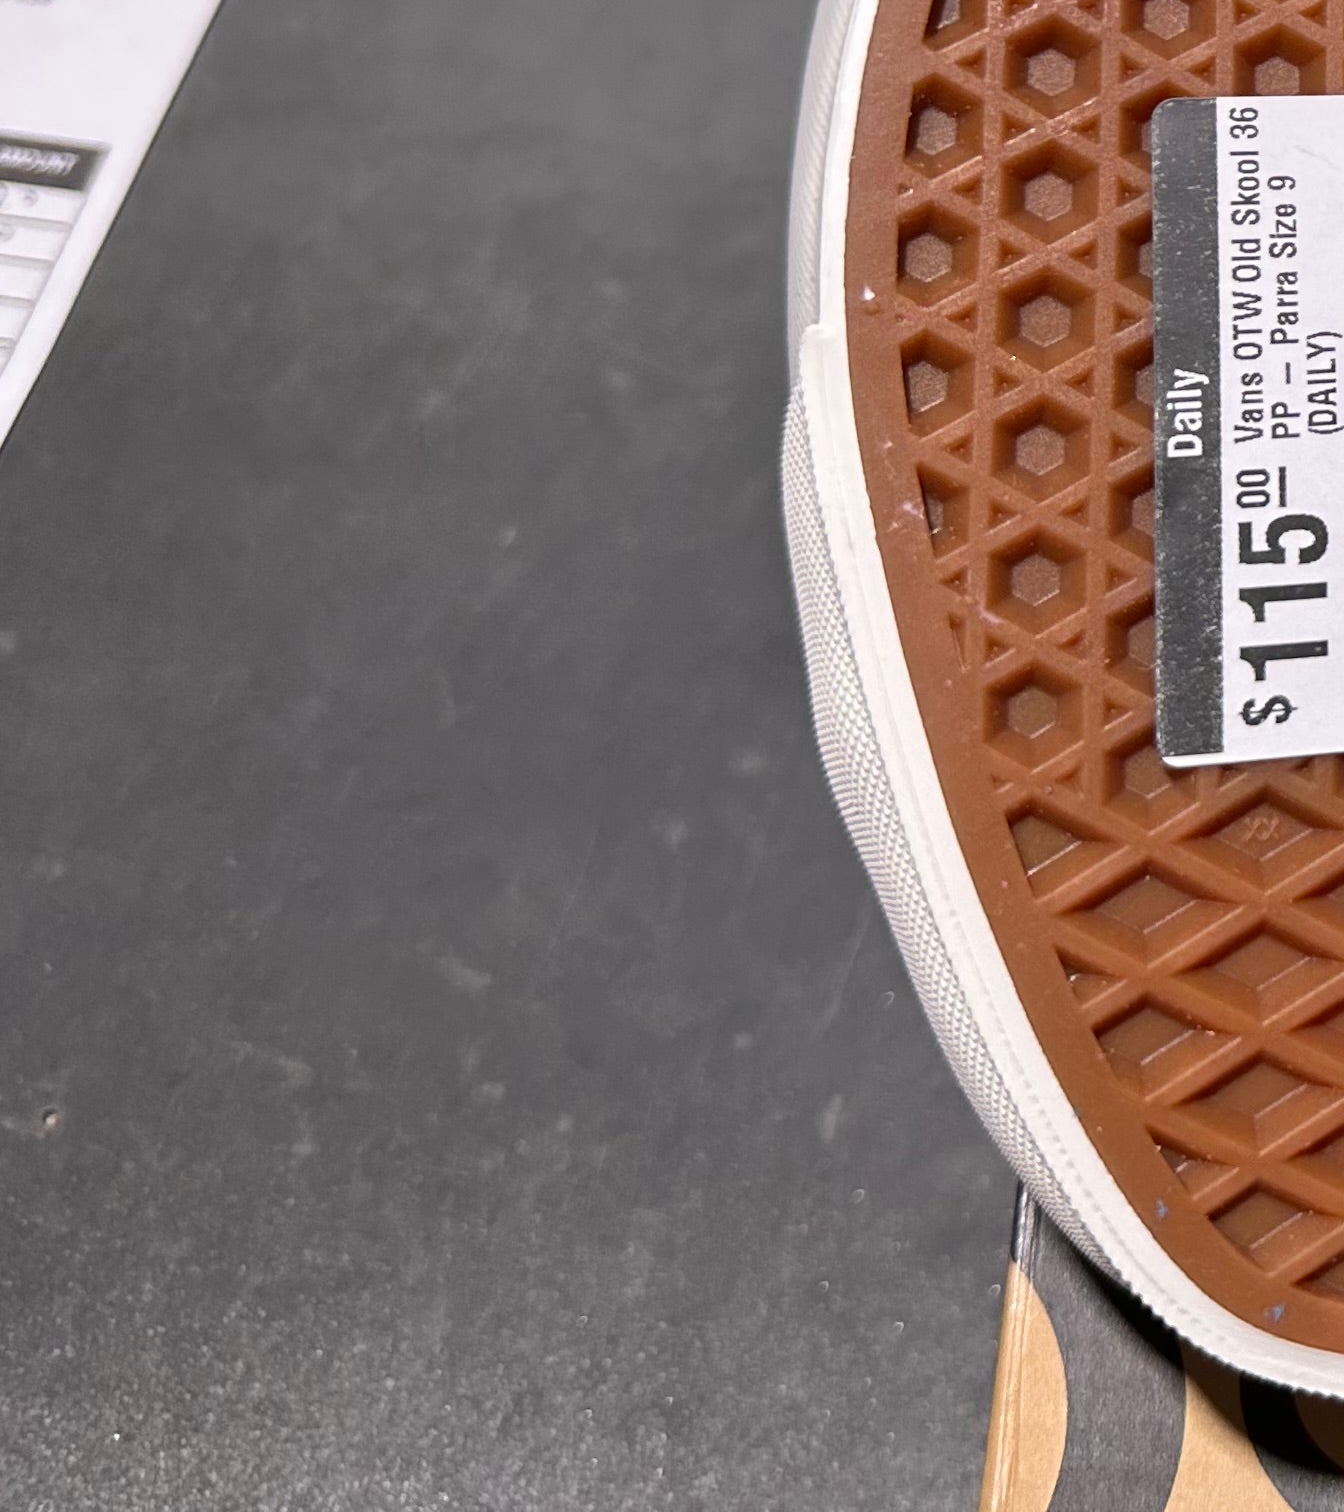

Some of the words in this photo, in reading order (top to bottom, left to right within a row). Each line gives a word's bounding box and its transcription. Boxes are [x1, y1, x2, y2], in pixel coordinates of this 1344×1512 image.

[1228, 106, 1259, 140] 36
[1228, 149, 1261, 226] Skool
[1265, 174, 1296, 191] 9
[1229, 237, 1262, 283] Old
[1267, 202, 1298, 259] Size
[1230, 290, 1263, 361] OTW
[1268, 270, 1300, 345] Parra
[1164, 367, 1210, 458] Daily
[1232, 371, 1264, 444] Vans
[1305, 330, 1344, 435] (DAILY)
[1269, 400, 1301, 440] PP
